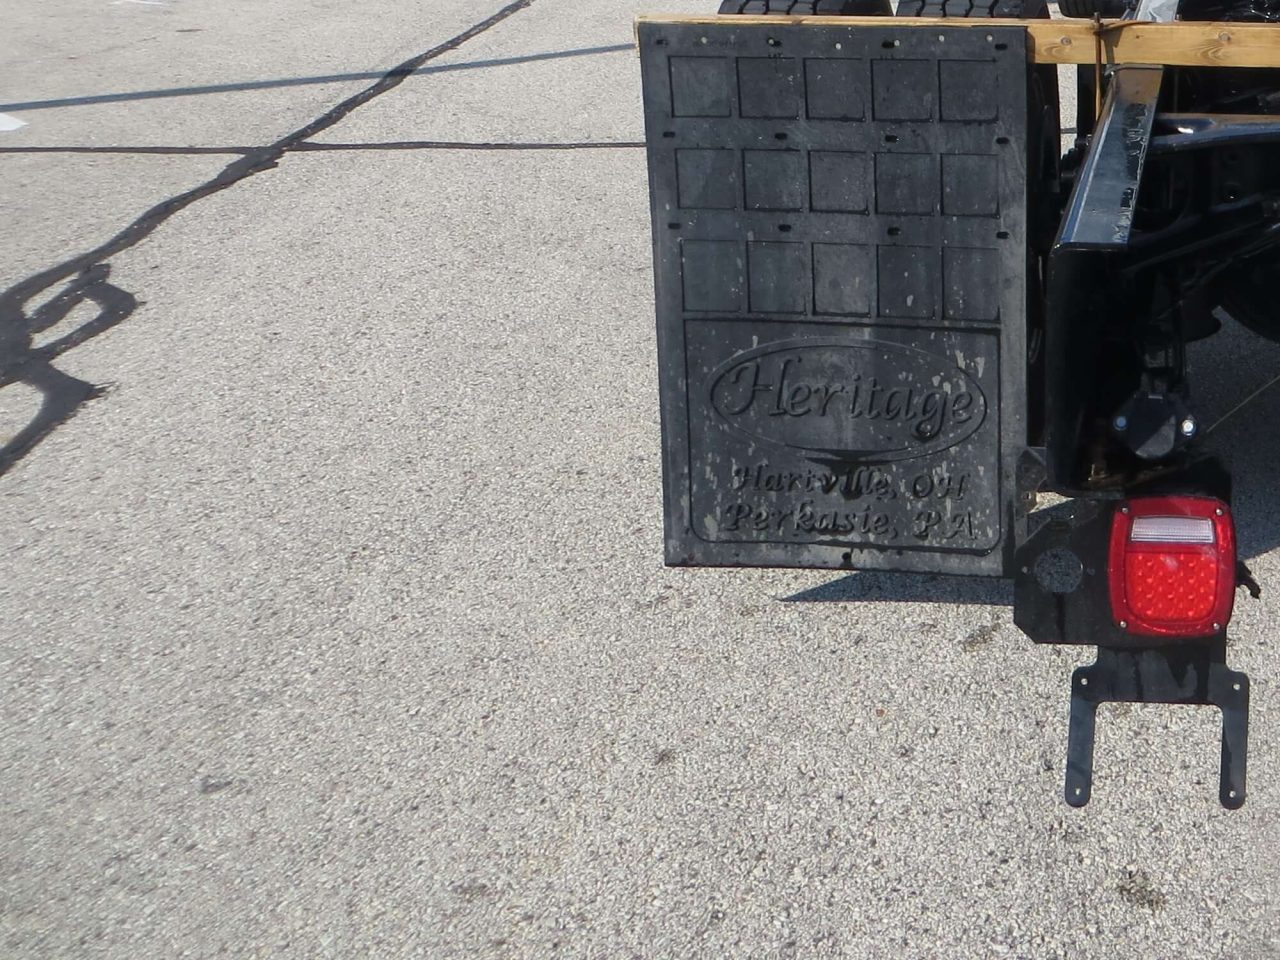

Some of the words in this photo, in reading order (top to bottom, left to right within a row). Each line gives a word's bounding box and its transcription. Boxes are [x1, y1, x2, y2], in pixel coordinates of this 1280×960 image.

[725, 357, 975, 443] Heritage
[911, 471, 972, 501] OH
[911, 509, 977, 541] PA
